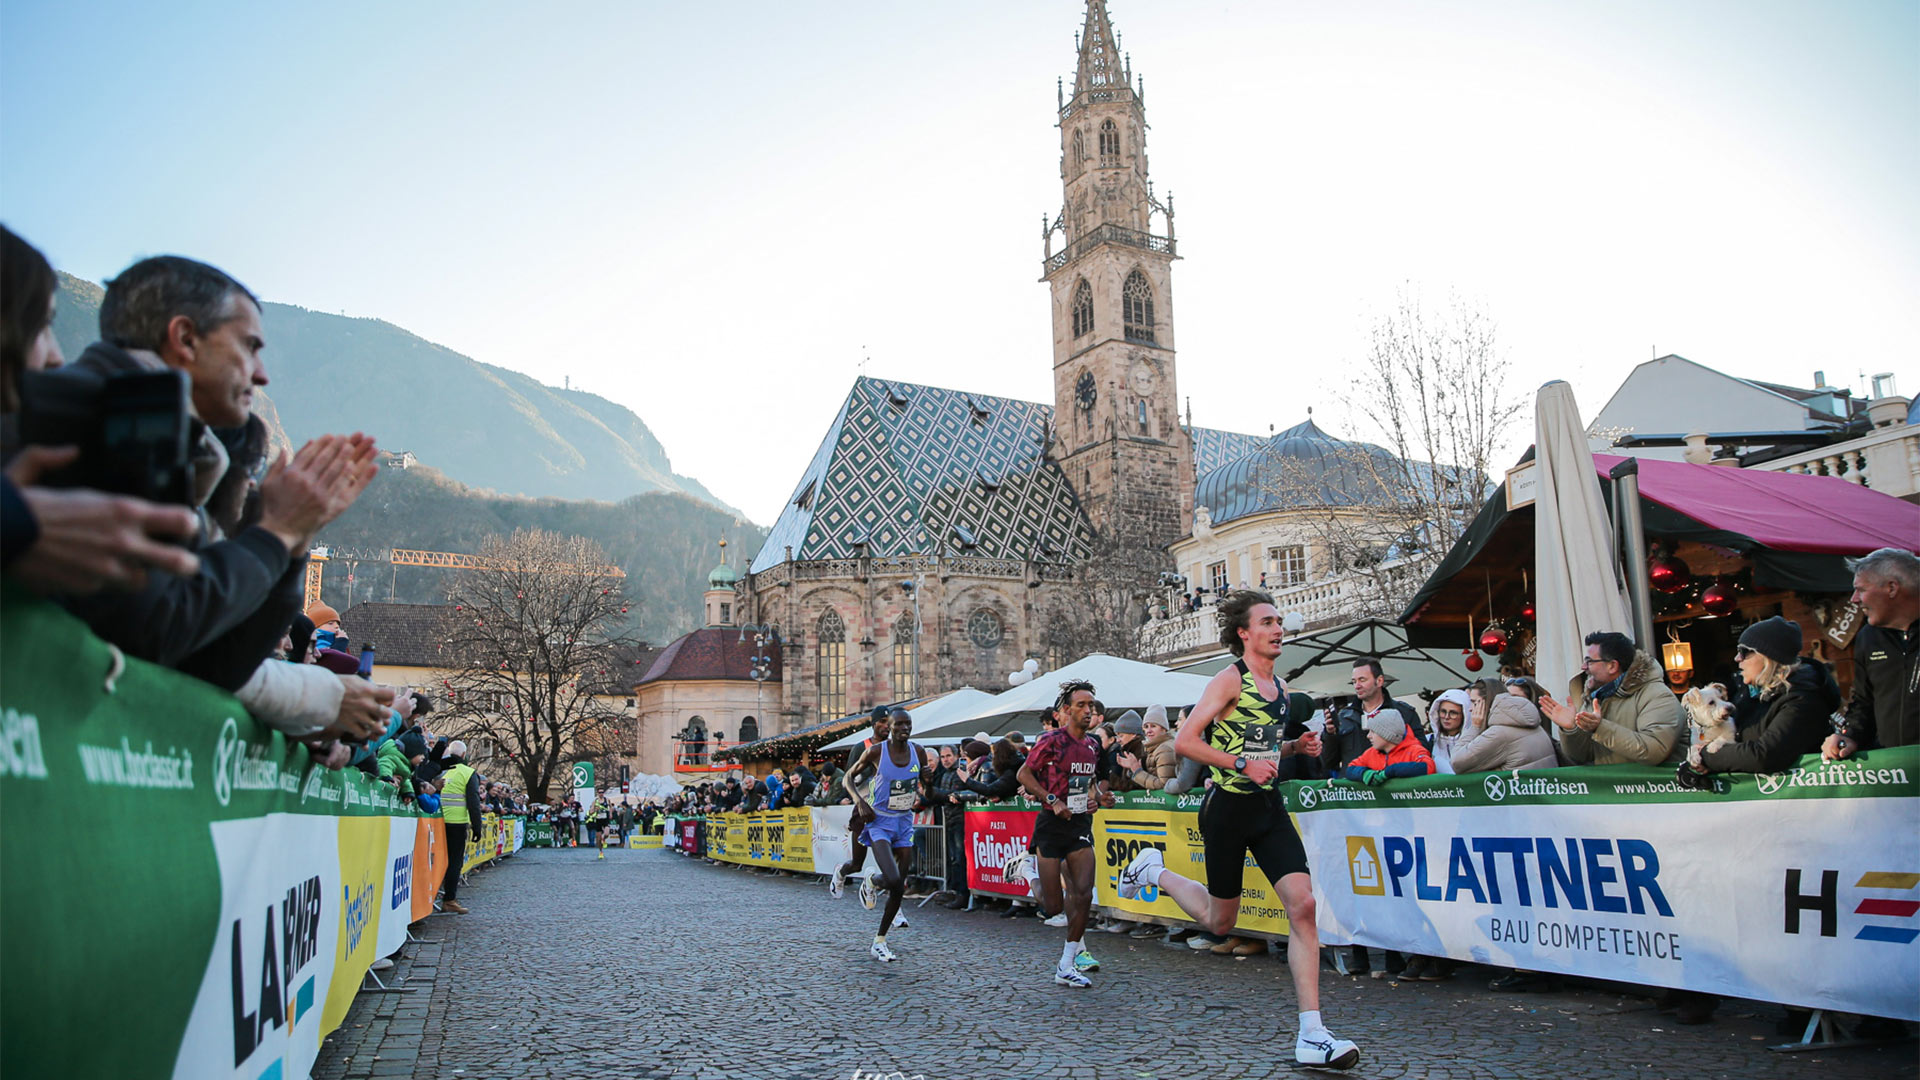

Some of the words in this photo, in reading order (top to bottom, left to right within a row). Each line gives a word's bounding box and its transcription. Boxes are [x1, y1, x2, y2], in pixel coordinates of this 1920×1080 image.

[1254, 727, 1264, 740] 3
[1074, 777, 1080, 788] 1
[1788, 764, 1909, 788] Raiffeisen
[895, 780, 902, 790] 6
[1509, 778, 1589, 797] Raiffeisen
[1318, 787, 1376, 802] Raiffeisen
[1391, 787, 1465, 800] www.boclassic.it
[990, 821, 1006, 830] PASTA
[1383, 836, 1675, 917] PLATTNER
[1491, 918, 1529, 944] BAU
[1538, 923, 1682, 961] COMPETENCE
